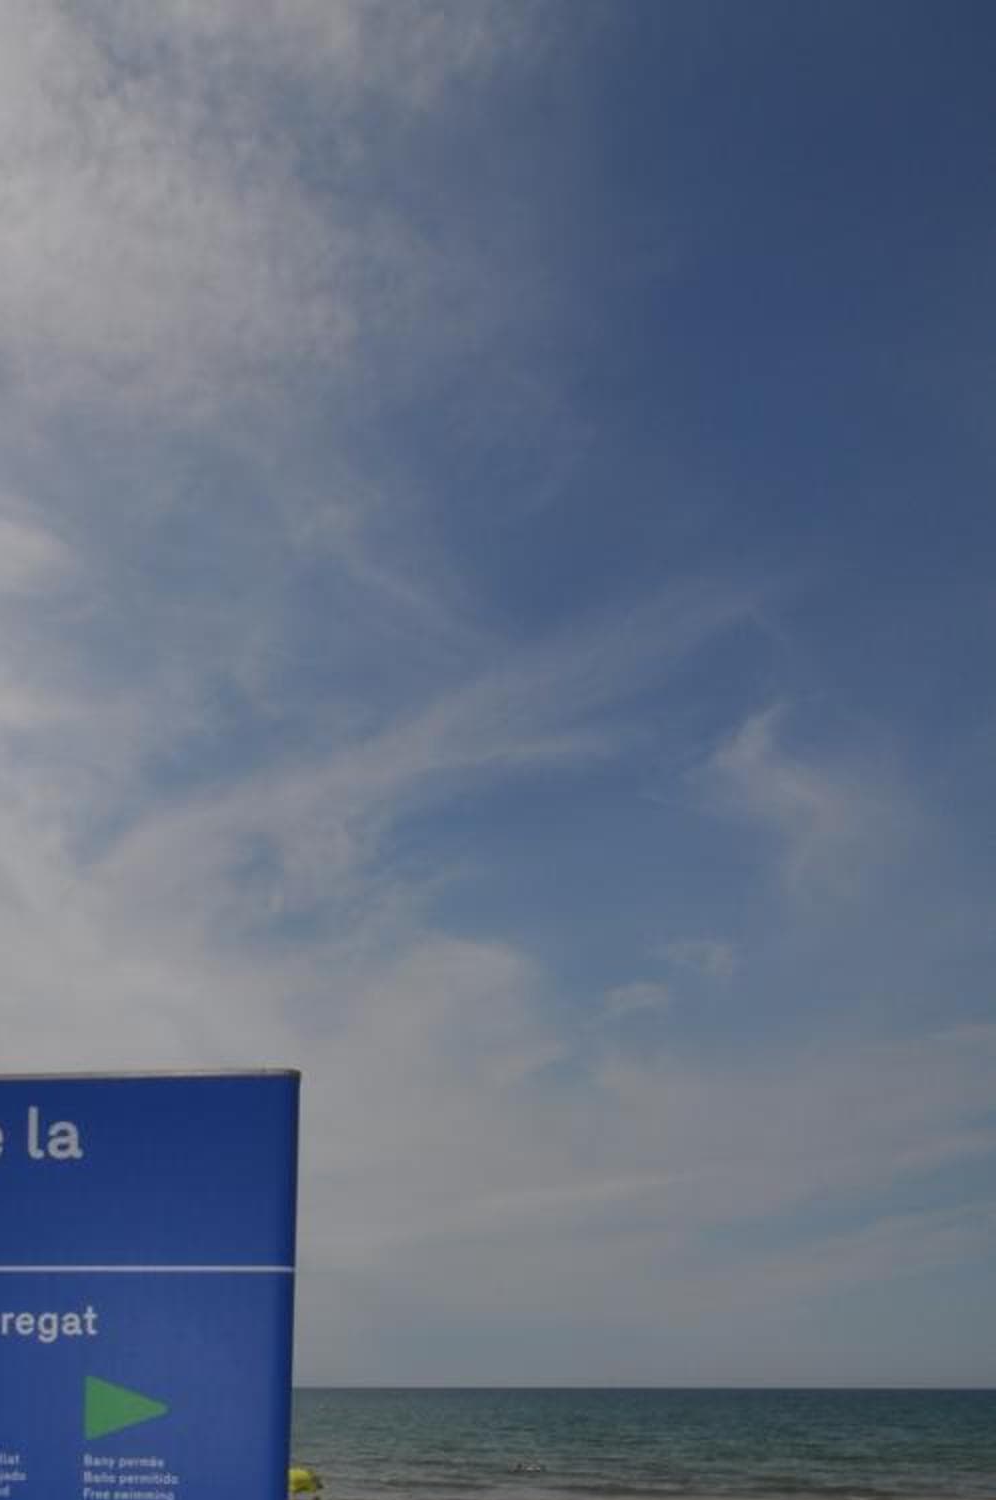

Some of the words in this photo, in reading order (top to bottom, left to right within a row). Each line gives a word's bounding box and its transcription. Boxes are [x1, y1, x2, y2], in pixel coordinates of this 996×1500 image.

[28, 1106, 83, 1160] la
[83, 1453, 115, 1469] Bany
[83, 1487, 111, 1500] Free
